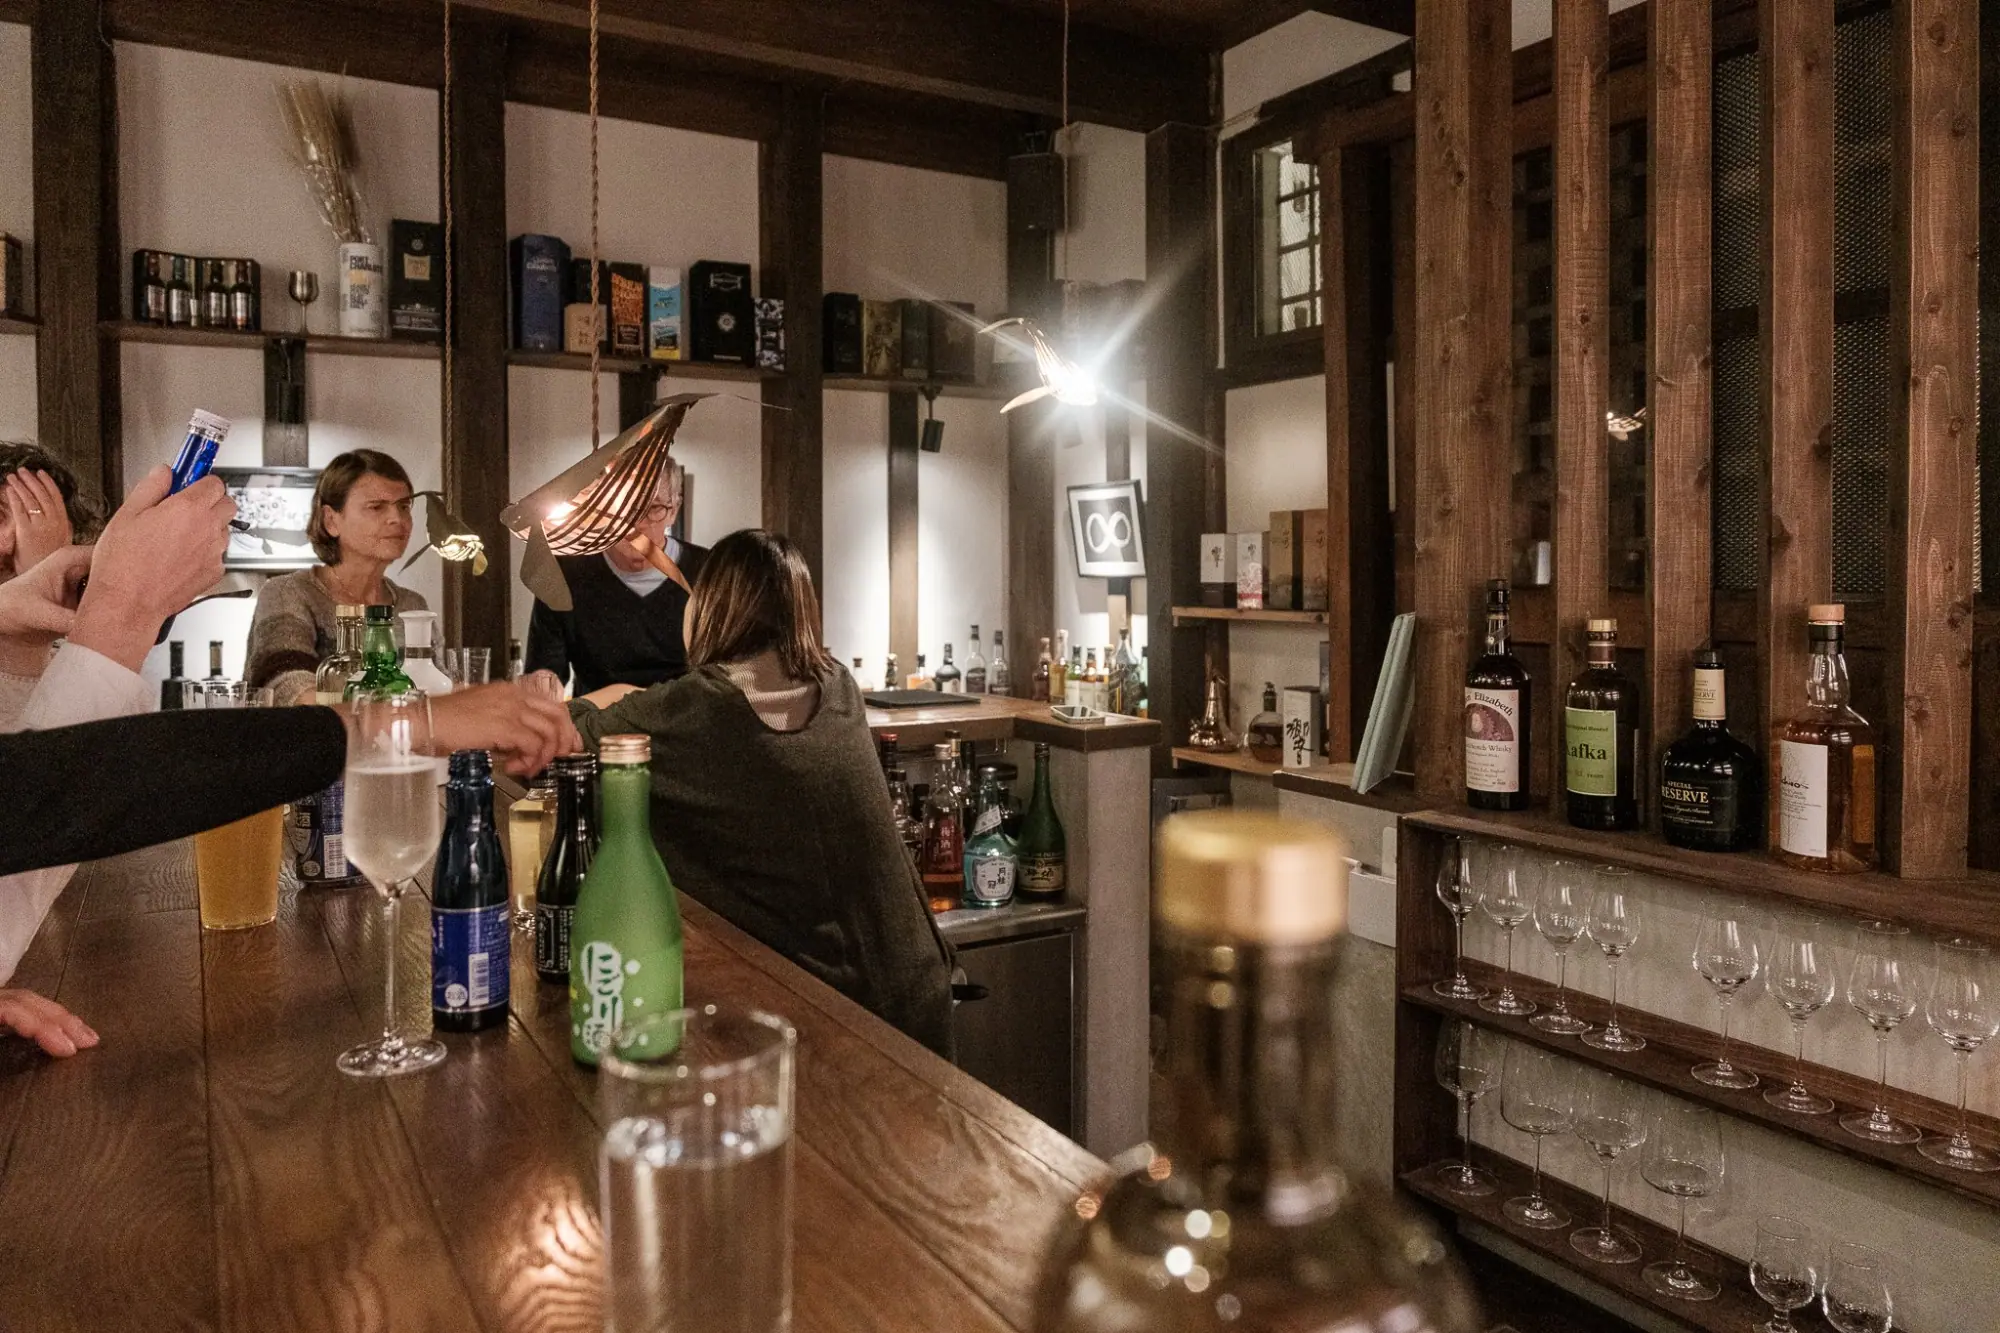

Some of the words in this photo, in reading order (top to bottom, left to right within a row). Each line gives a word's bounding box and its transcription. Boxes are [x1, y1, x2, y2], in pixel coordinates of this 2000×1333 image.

[1474, 691, 1513, 716] Elizabeth
[1661, 785, 1709, 803] RESERVE
[1667, 780, 1693, 790] SPECIAL
